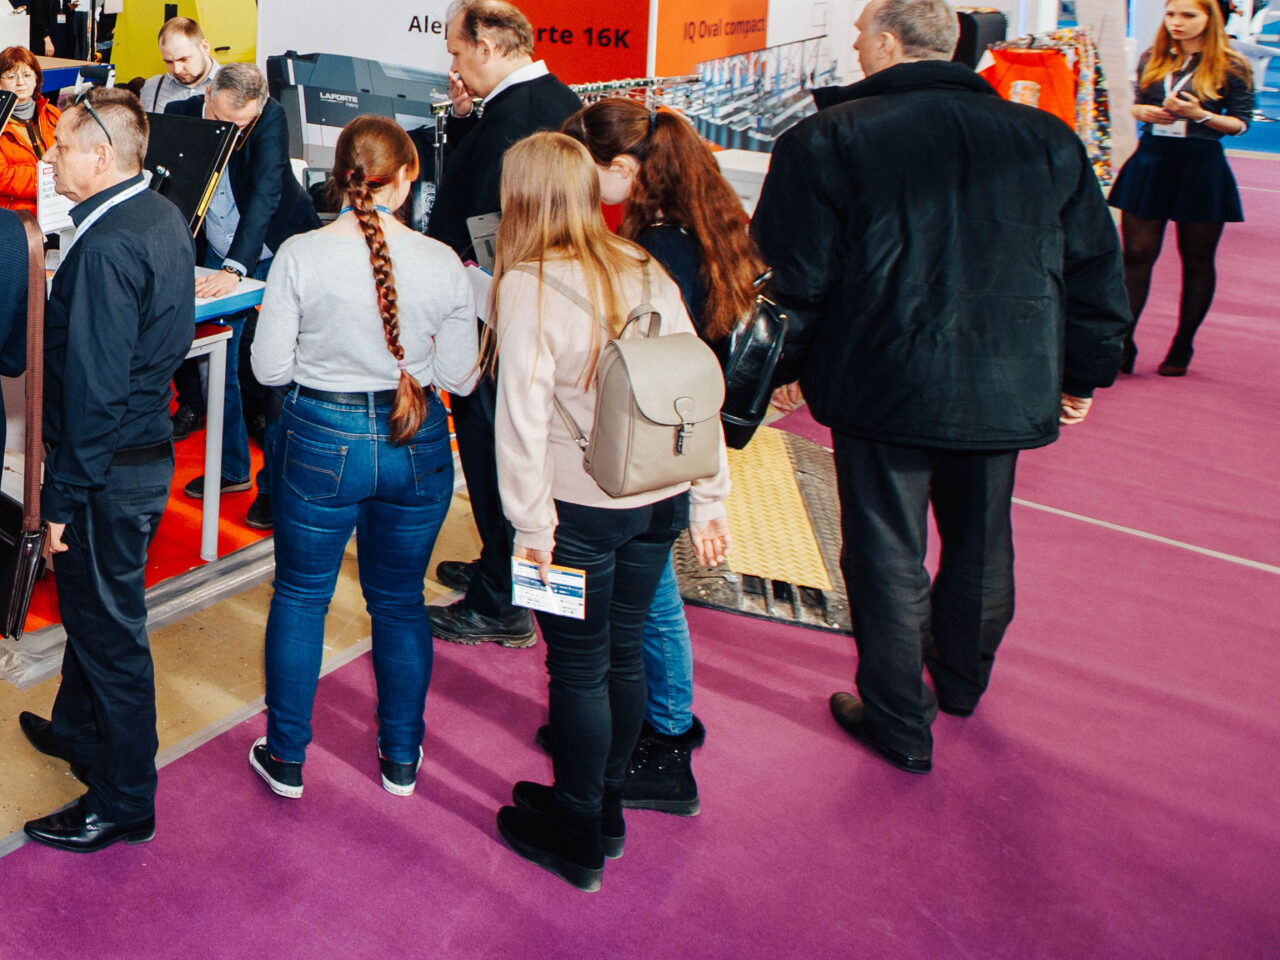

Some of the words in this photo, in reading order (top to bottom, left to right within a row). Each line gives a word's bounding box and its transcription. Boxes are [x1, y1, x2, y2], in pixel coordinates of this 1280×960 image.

[408, 15, 448, 40] Ale
[583, 27, 631, 49] 16K
[683, 21, 696, 44] IQ
[699, 17, 722, 39] Oval
[725, 18, 766, 39] compact
[320, 91, 358, 103] LAFORTE
